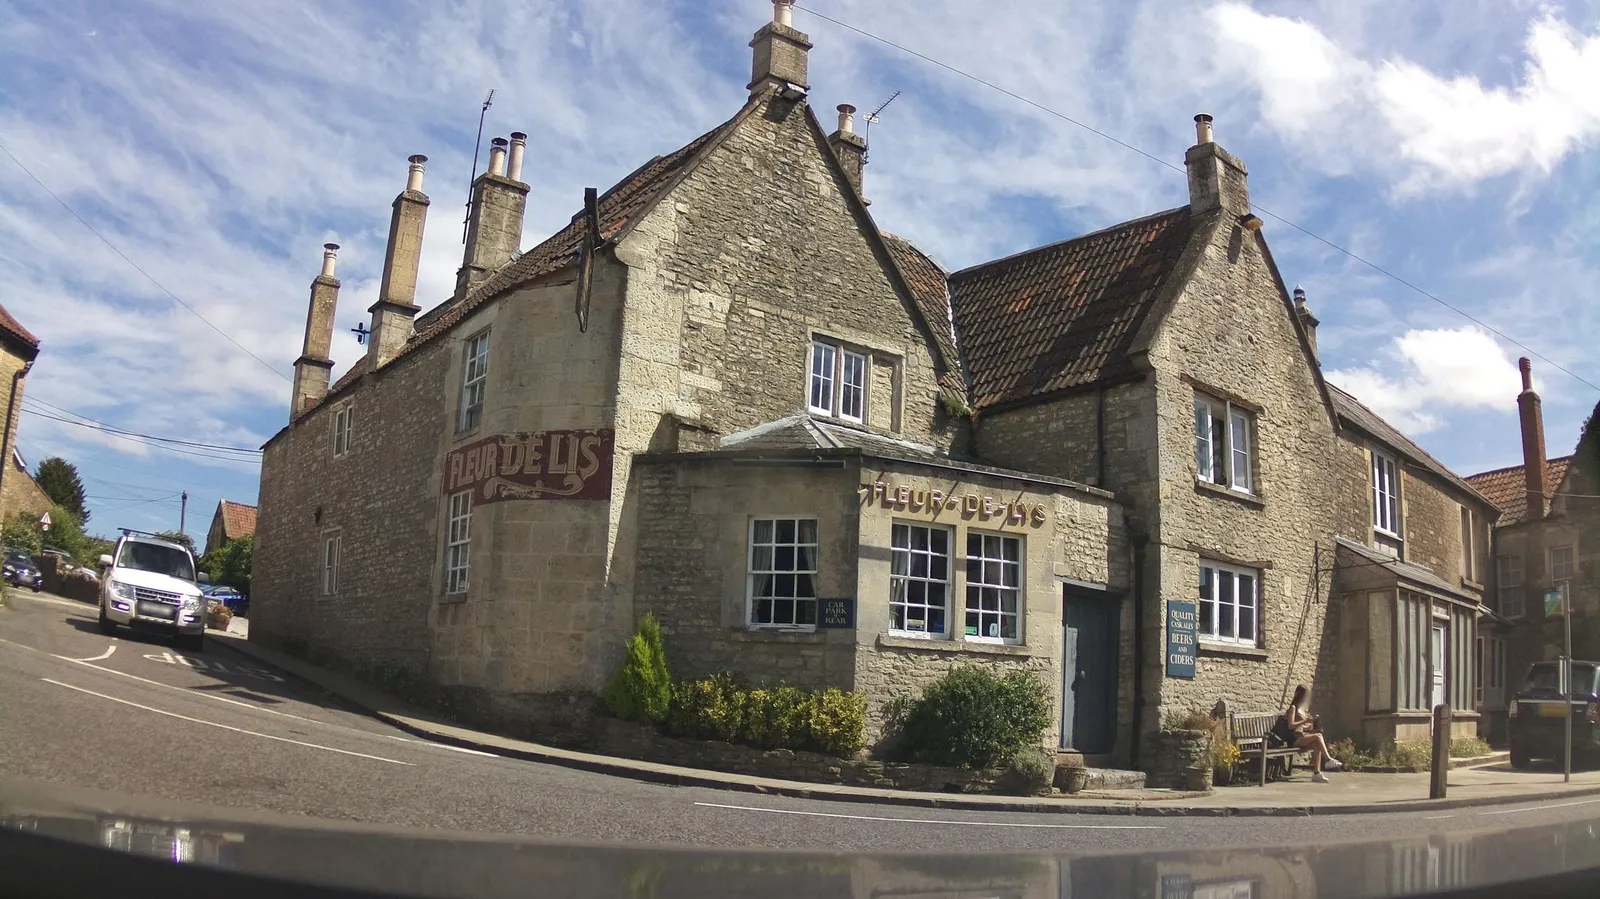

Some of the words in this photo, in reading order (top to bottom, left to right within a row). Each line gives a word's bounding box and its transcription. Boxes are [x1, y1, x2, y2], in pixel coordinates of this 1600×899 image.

[450, 442, 498, 489] FLEUR
[501, 437, 543, 475] DE
[548, 434, 601, 480] LIS
[1171, 610, 1194, 621] QUALITY
[1171, 621, 1182, 629] CASK
[1183, 622, 1193, 630] ALES
[1171, 633, 1193, 645] BEERS
[1170, 654, 1194, 665] CIDERS
